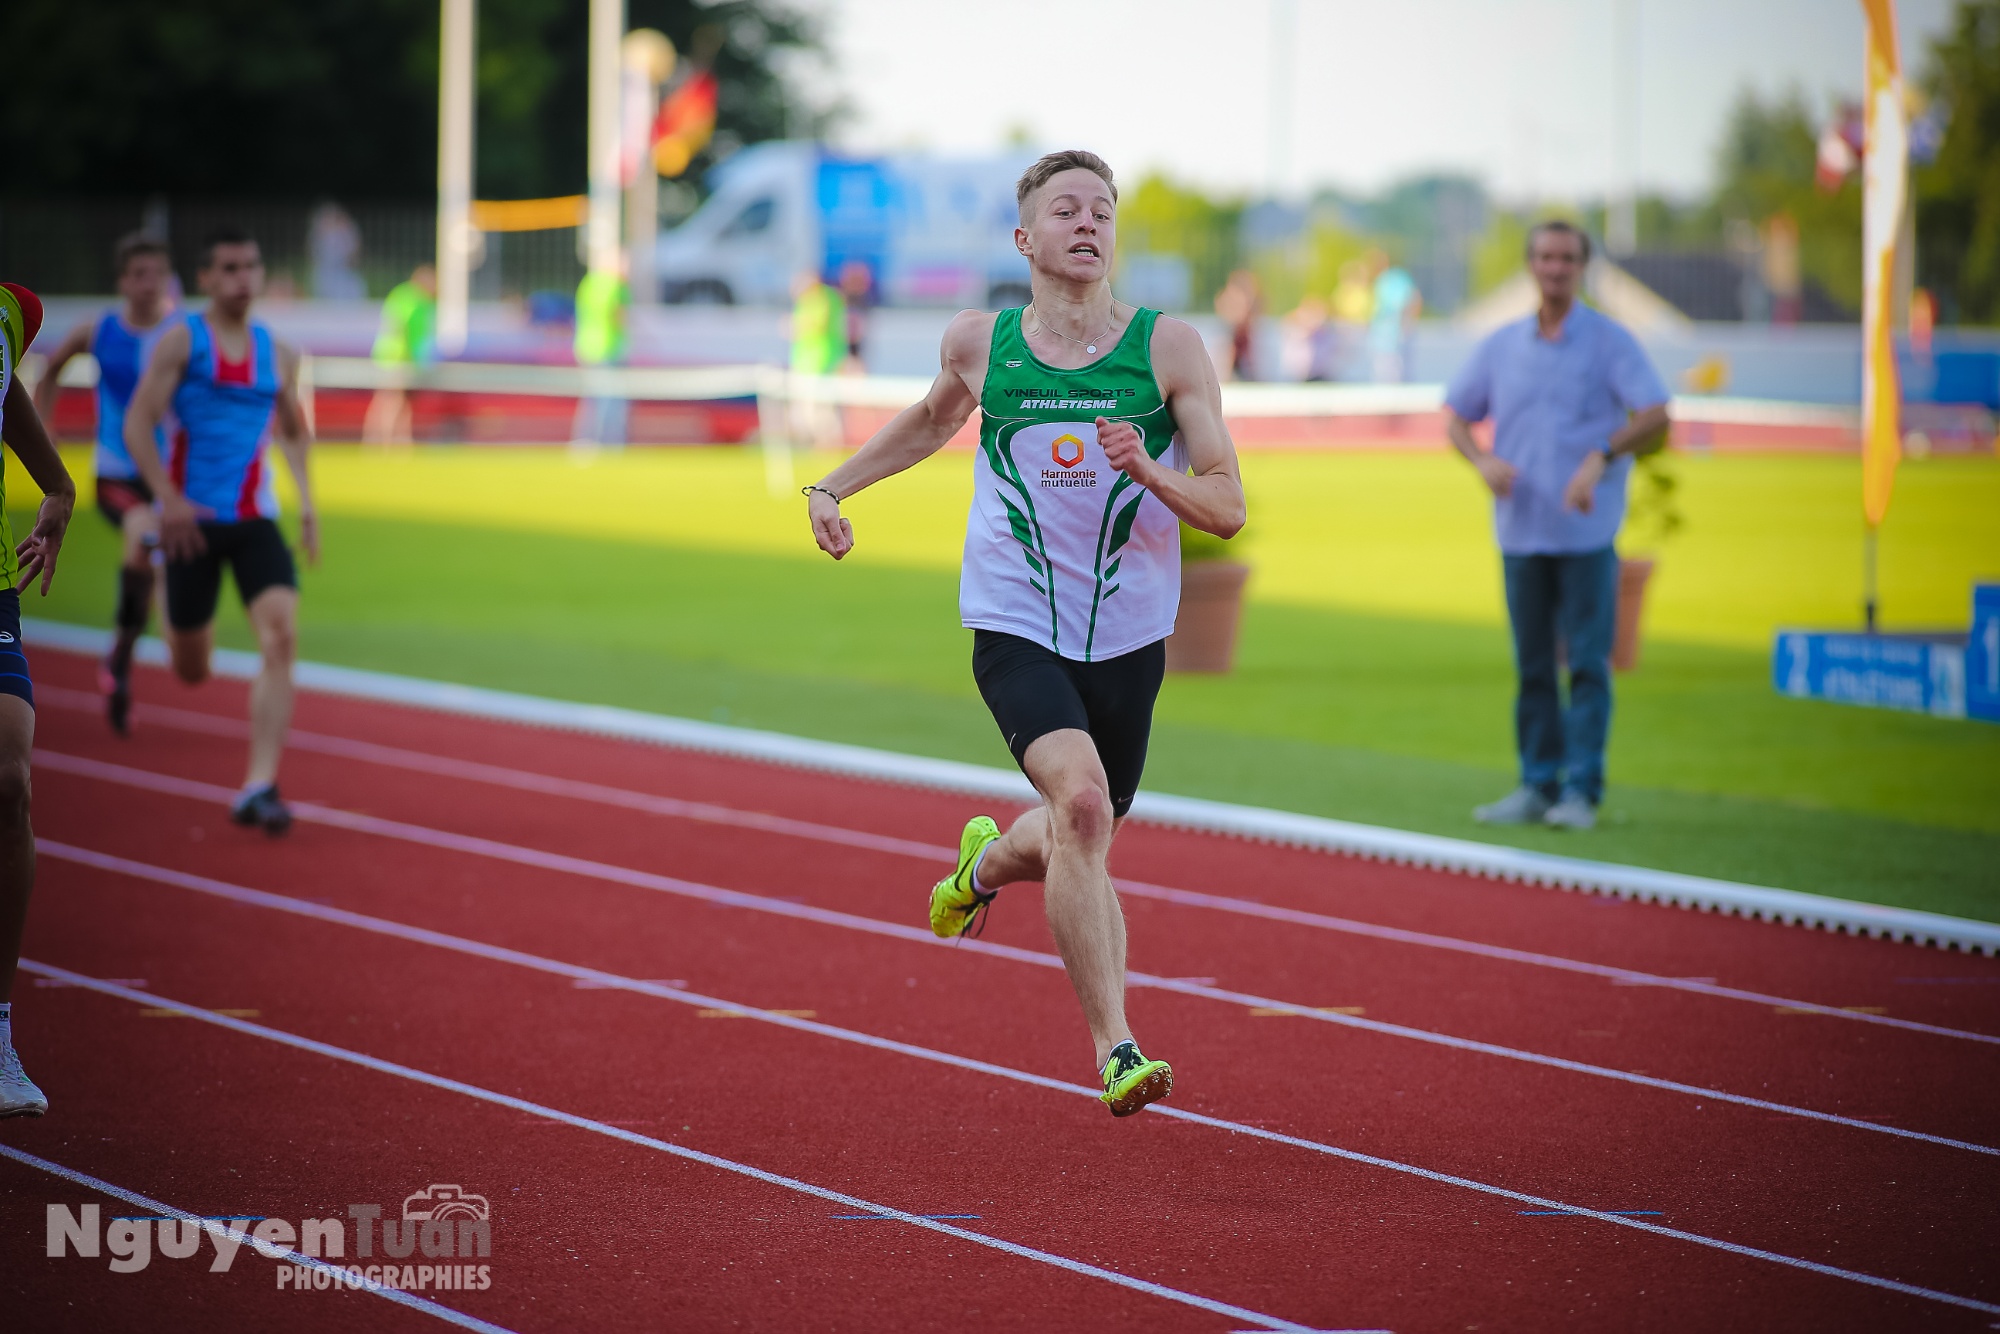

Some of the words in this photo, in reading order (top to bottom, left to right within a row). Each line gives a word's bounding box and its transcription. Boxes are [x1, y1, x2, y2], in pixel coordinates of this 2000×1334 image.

[1003, 388, 1063, 398] VINEUIL
[1067, 388, 1136, 398] SPORTS
[1019, 399, 1118, 410] ATHLETISME
[1041, 469, 1097, 479] Harmonie
[1041, 478, 1097, 488] mutuelle
